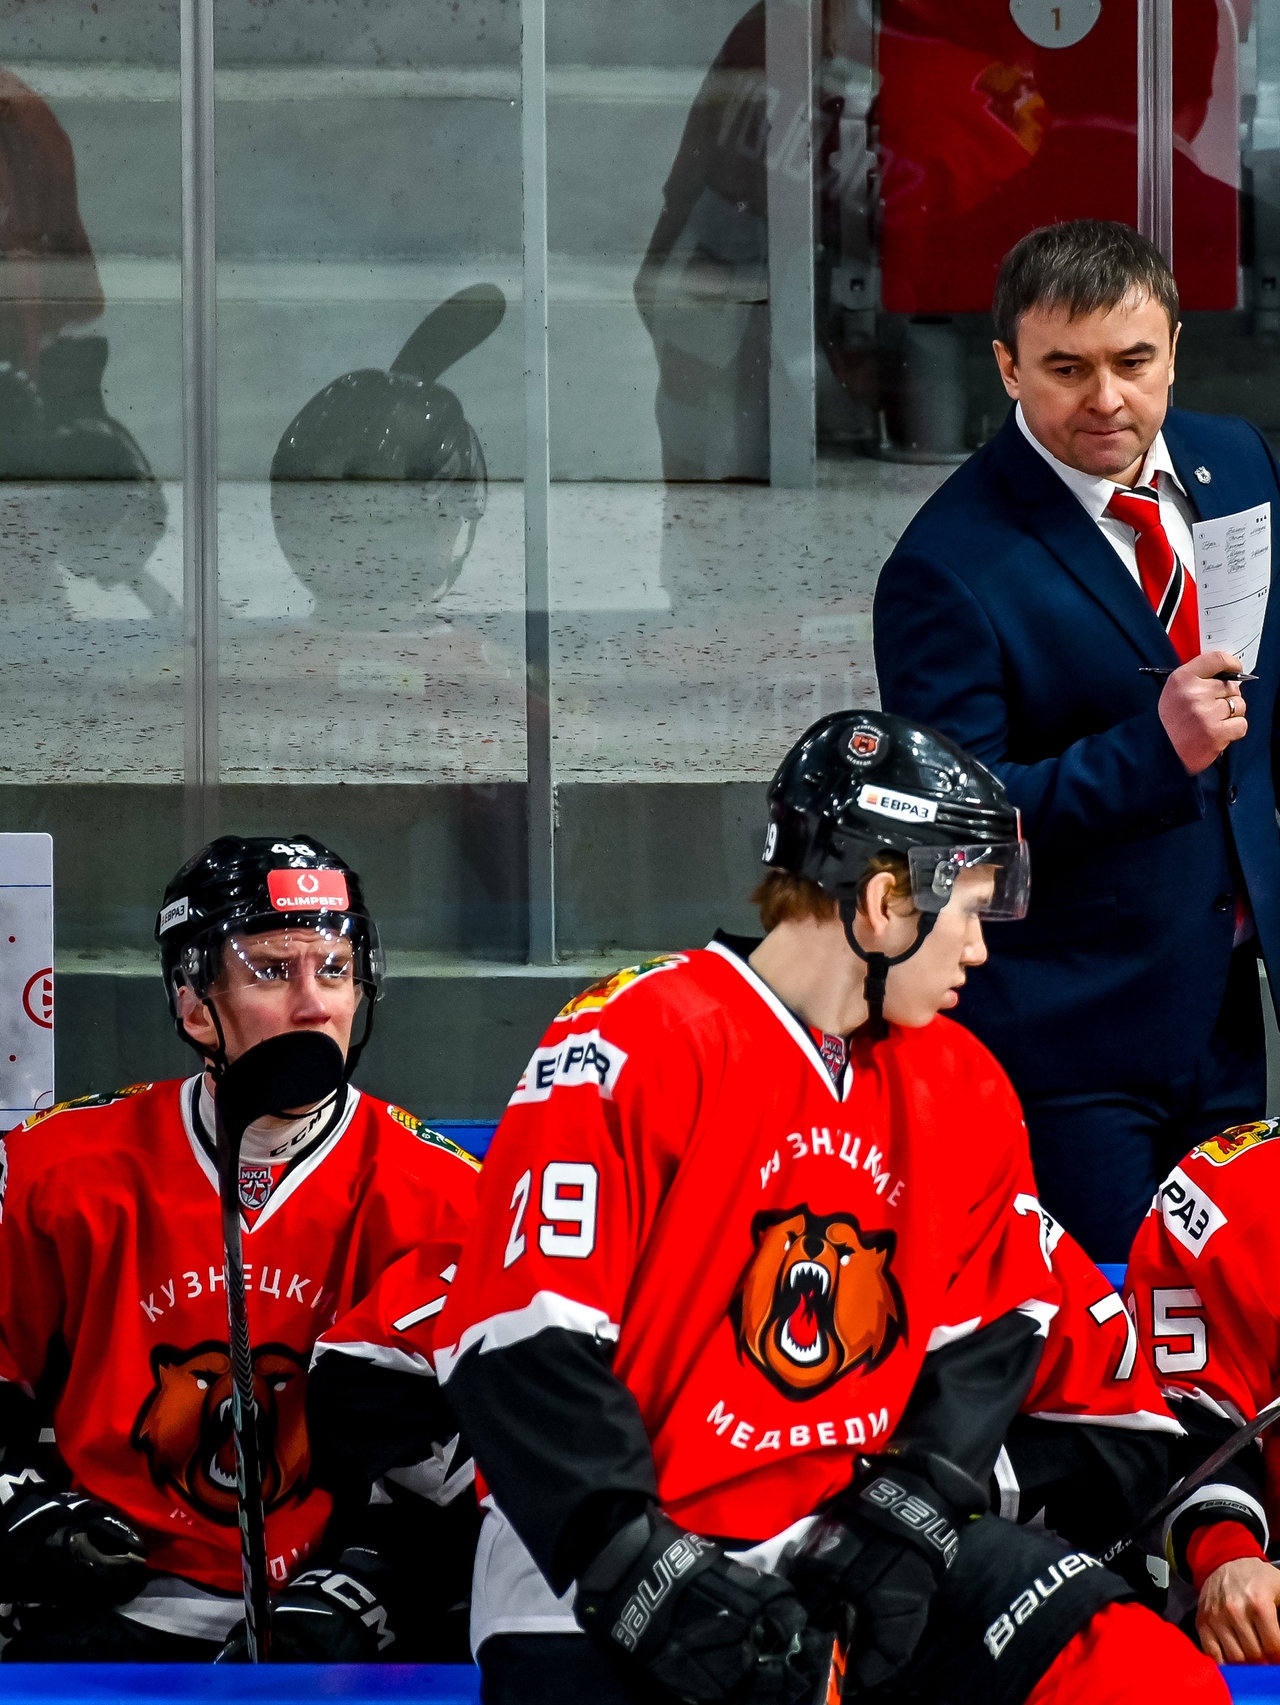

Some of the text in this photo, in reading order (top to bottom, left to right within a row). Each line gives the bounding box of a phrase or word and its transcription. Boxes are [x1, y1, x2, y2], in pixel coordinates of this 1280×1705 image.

[1051, 8, 1061, 31] 1
[880, 796, 929, 819] ЕВРАЗ
[762, 823, 778, 863] 9
[276, 897, 344, 907] OLIMPBET
[269, 1109, 322, 1157] CCM
[241, 1171, 267, 1179] МХЛ
[503, 1160, 600, 1269] 29
[706, 1400, 889, 1451] МЕДВЕДИ
[288, 1569, 397, 1651] CCM
